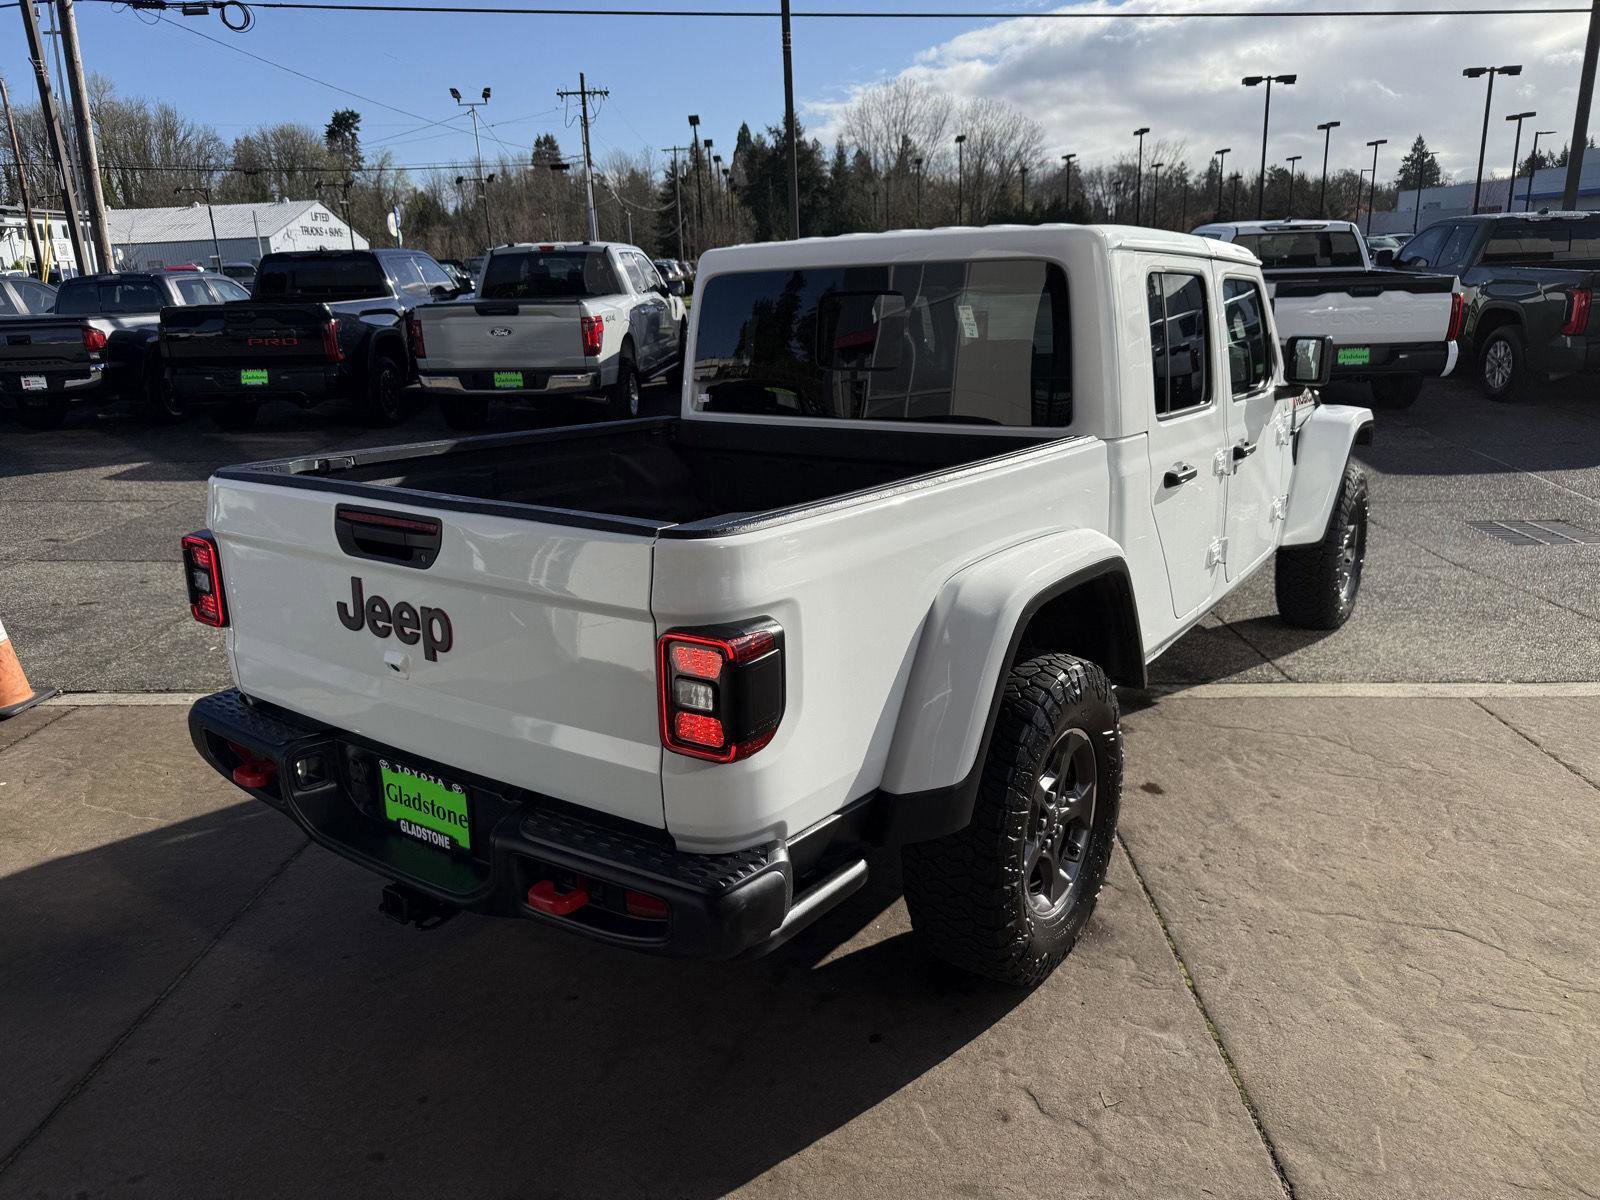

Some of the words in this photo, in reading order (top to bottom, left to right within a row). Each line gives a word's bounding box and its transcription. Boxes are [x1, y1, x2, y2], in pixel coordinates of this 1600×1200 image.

[310, 211, 330, 222] LIFTED
[299, 225, 324, 236] TRUCKS
[492, 327, 510, 336] Ford
[247, 338, 299, 347] PRO
[336, 576, 453, 662] Jeep
[395, 764, 446, 790] TOYOTA
[385, 782, 469, 829] Gladstone
[400, 819, 451, 849] GLADSTONE
